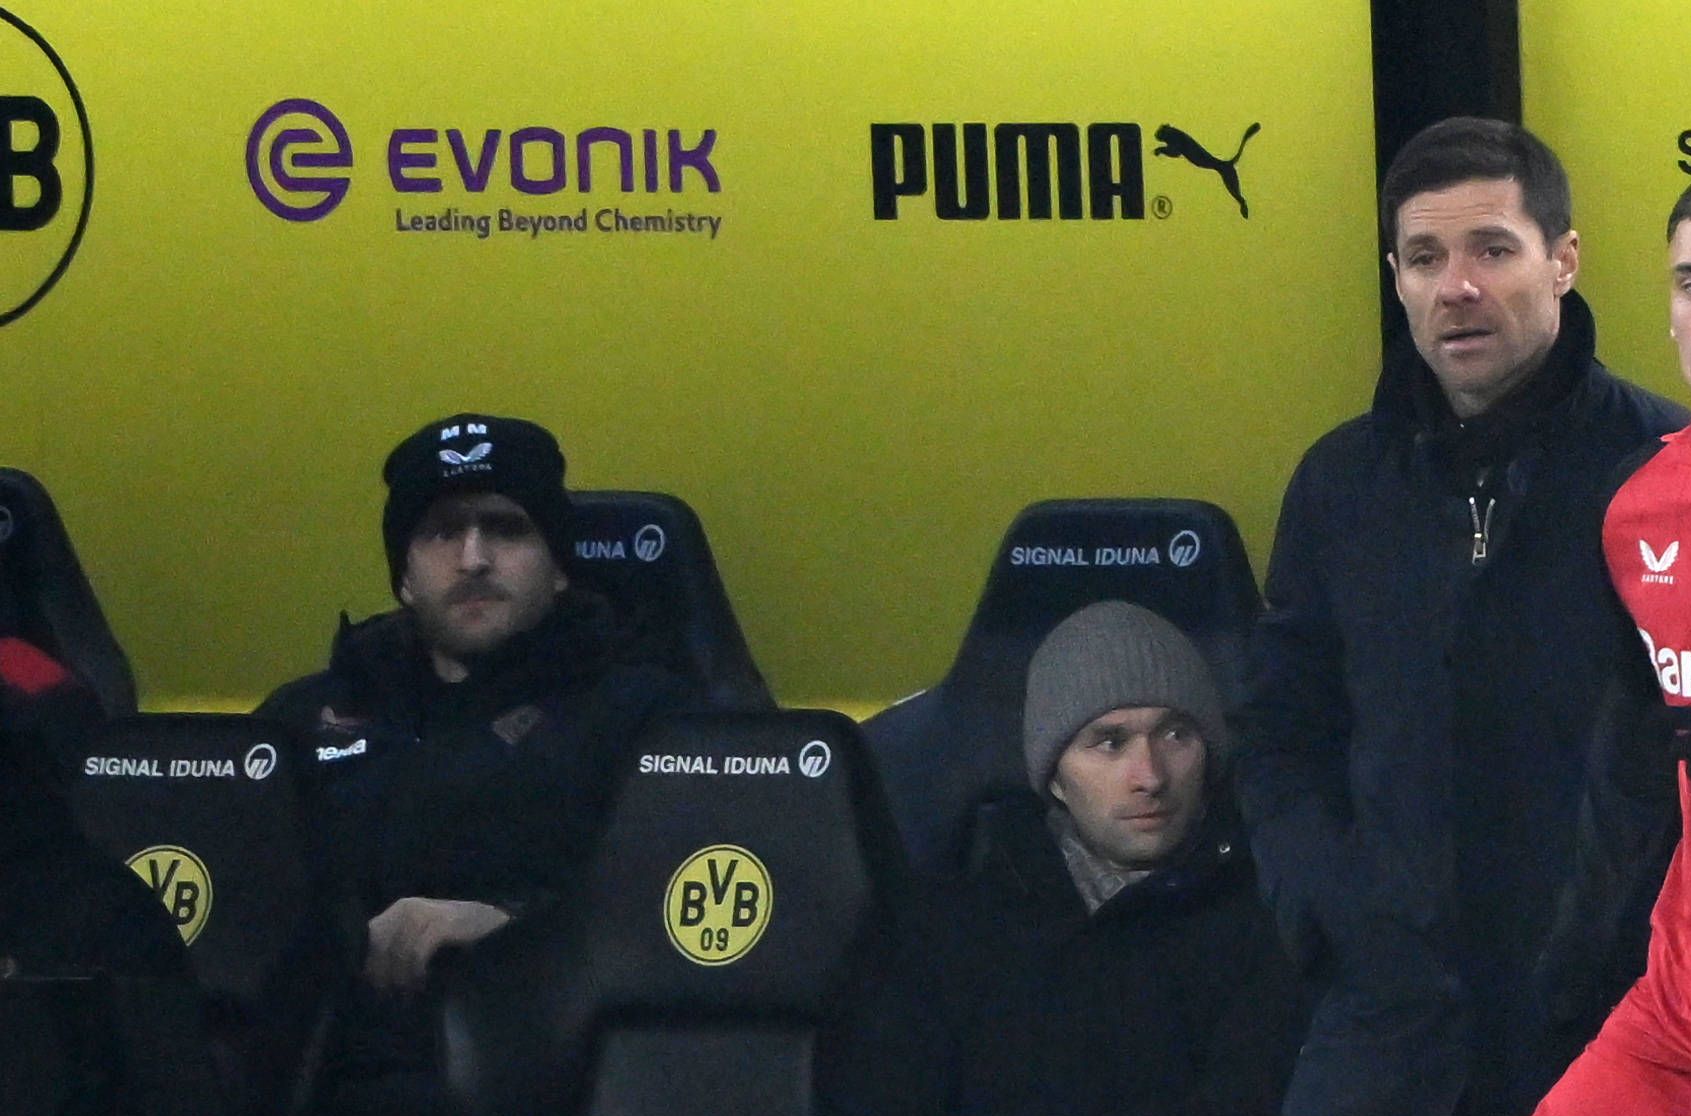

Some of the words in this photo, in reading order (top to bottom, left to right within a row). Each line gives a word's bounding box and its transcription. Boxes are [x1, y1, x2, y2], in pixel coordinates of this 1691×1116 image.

[388, 128, 721, 194] EVONIK
[871, 122, 1145, 220] PUMA
[396, 209, 491, 238] Leading
[498, 209, 588, 239] Beyond
[595, 208, 722, 239] Chemistry
[1011, 547, 1089, 566] SIGNAL
[1095, 548, 1160, 566] IDUNA
[85, 757, 163, 776] SIGNAL
[170, 759, 235, 777] IDUNA
[639, 755, 718, 774] SIGNAL
[724, 757, 791, 775] IDUNA
[680, 859, 760, 927] BVB
[700, 928, 729, 951] 09
